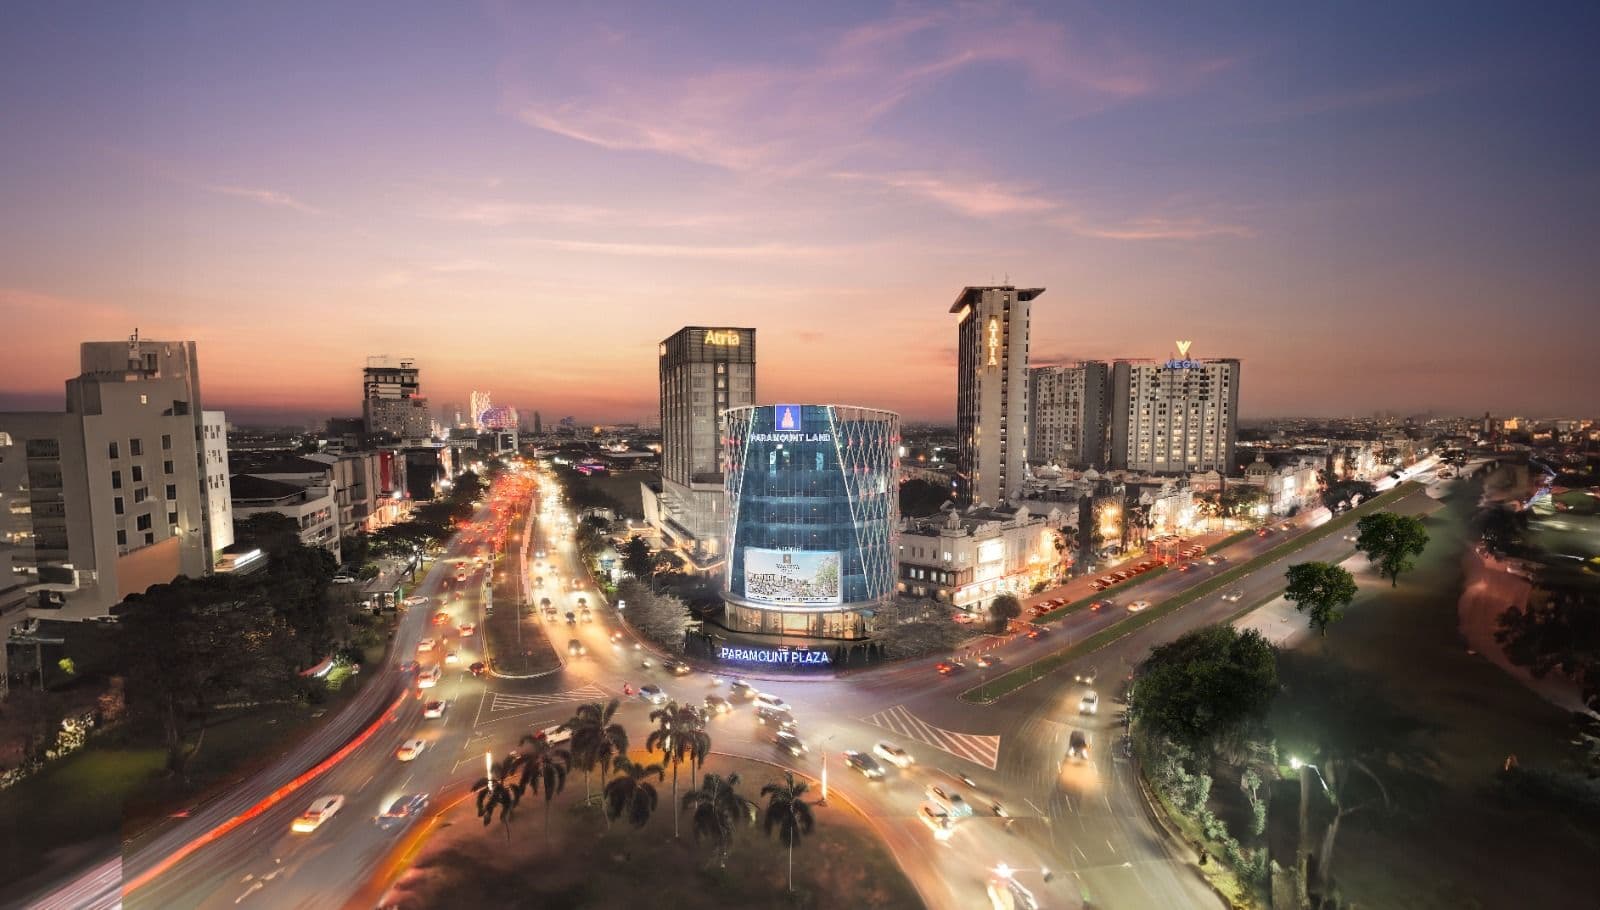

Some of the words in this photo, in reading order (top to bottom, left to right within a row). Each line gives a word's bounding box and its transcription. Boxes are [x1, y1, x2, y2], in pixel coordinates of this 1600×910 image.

[704, 330, 739, 346] Atria
[988, 319, 999, 366] ATRIA
[1165, 360, 1200, 369] VEGA
[750, 433, 804, 442] PARAMOUNT
[806, 433, 831, 442] LAND
[721, 647, 789, 663] PARAMOUNT
[791, 651, 830, 664] PLAZA
